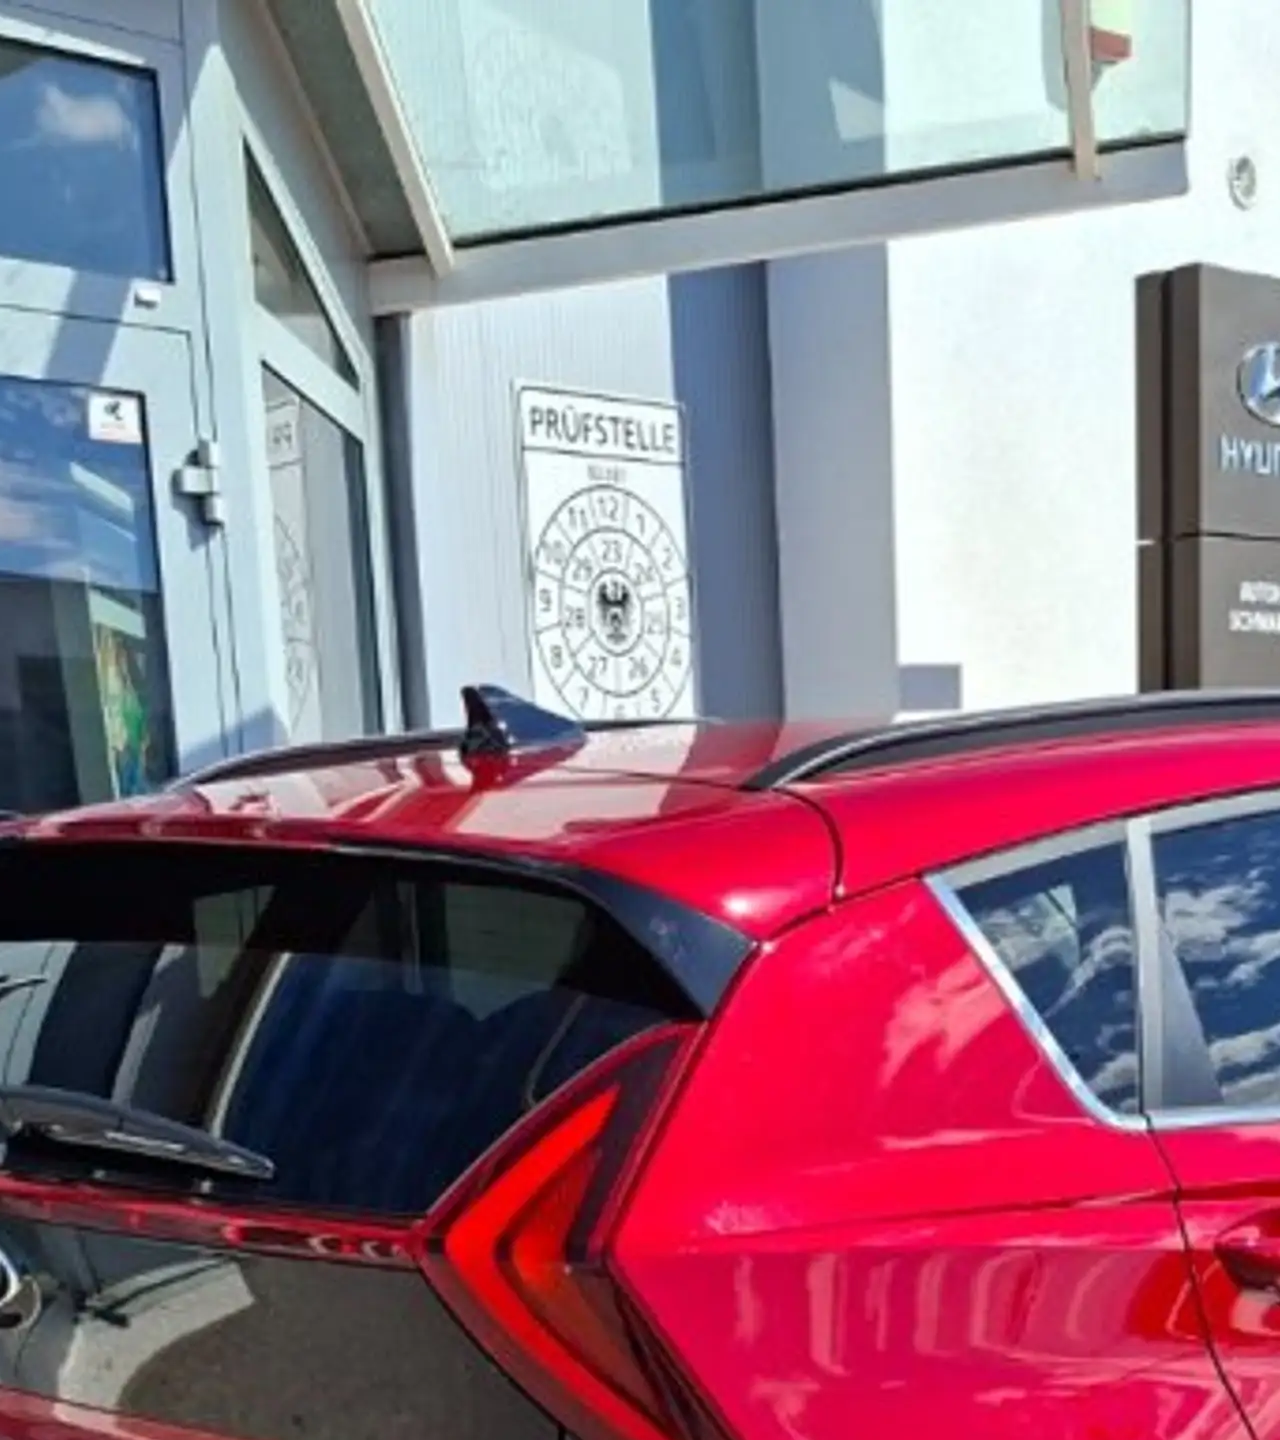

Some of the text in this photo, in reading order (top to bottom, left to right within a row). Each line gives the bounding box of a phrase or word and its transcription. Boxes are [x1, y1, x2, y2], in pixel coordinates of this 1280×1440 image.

[529, 405, 675, 454] PRÜFSTELLE
[568, 507, 588, 530] 11
[597, 495, 619, 521] 12
